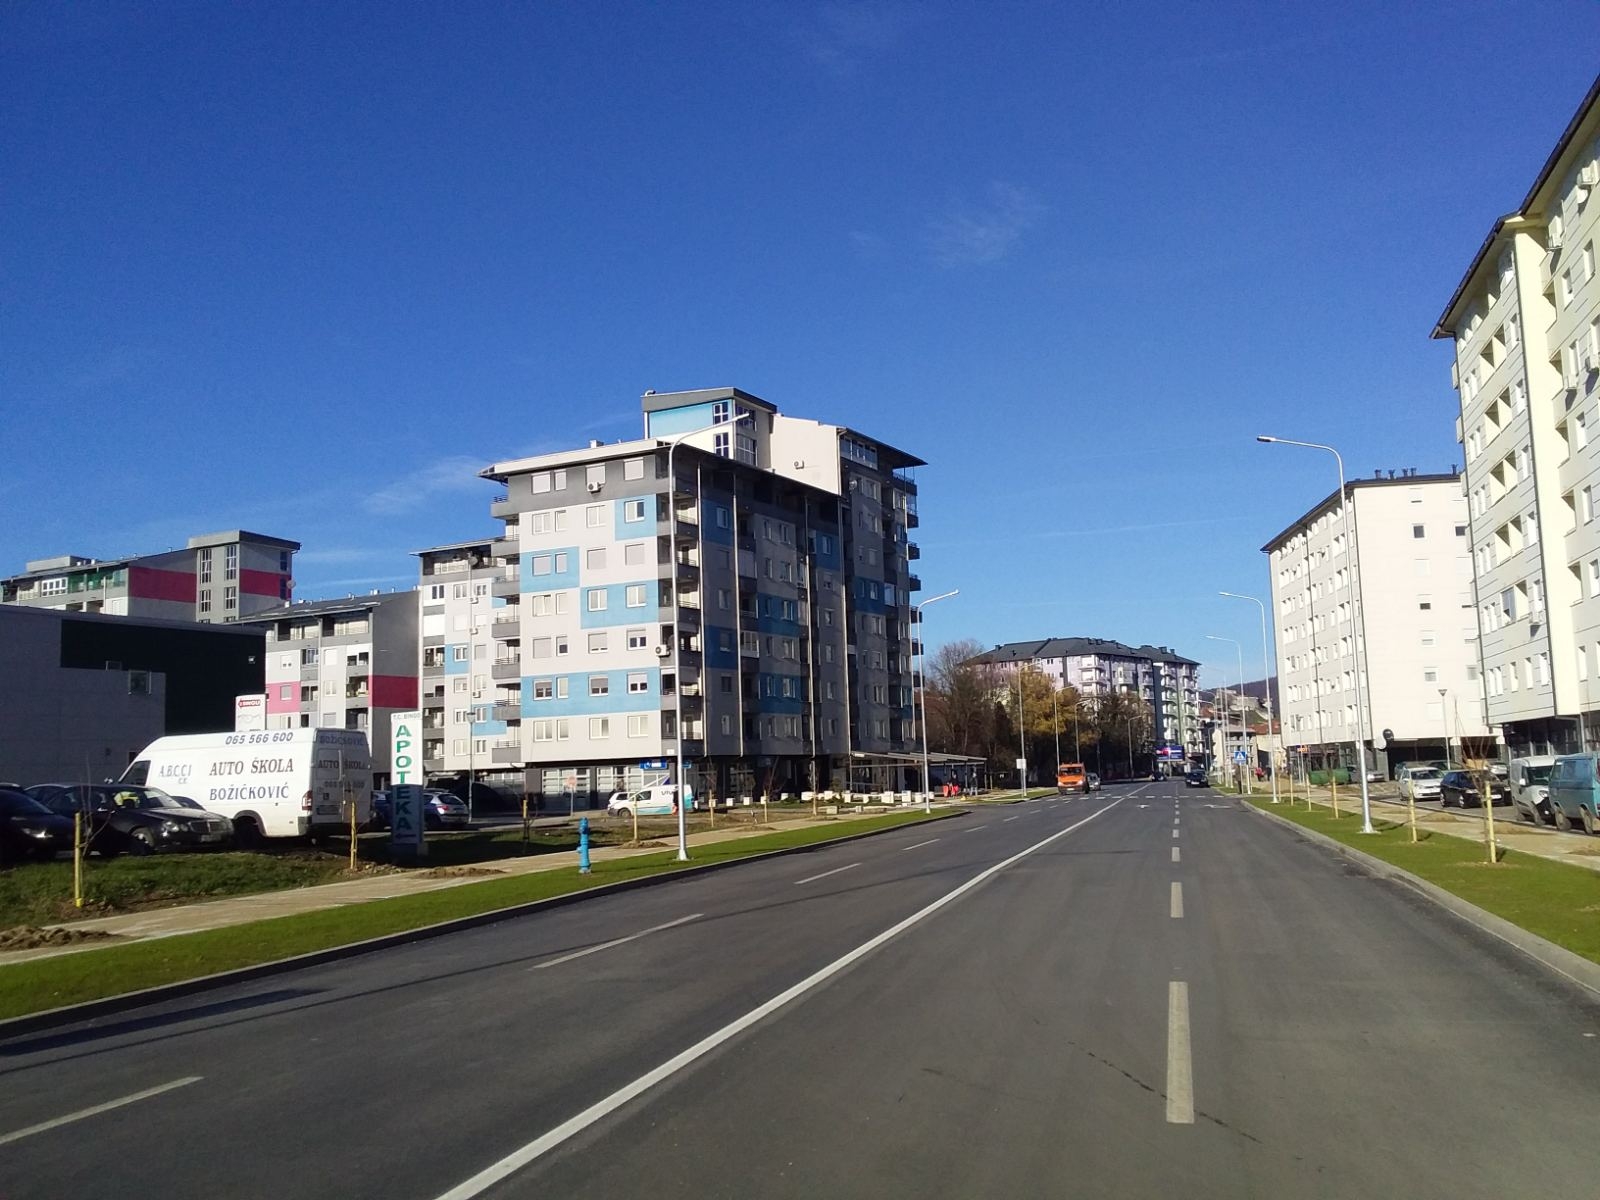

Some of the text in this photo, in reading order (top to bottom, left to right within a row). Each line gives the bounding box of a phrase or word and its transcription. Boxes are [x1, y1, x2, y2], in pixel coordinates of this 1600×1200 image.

[225, 732, 294, 745] 065 566 600
[209, 757, 294, 776] AUTO ŠKOLA
[318, 760, 340, 769] AUTO
[209, 782, 289, 801] BOŽIČKOVIĆ
